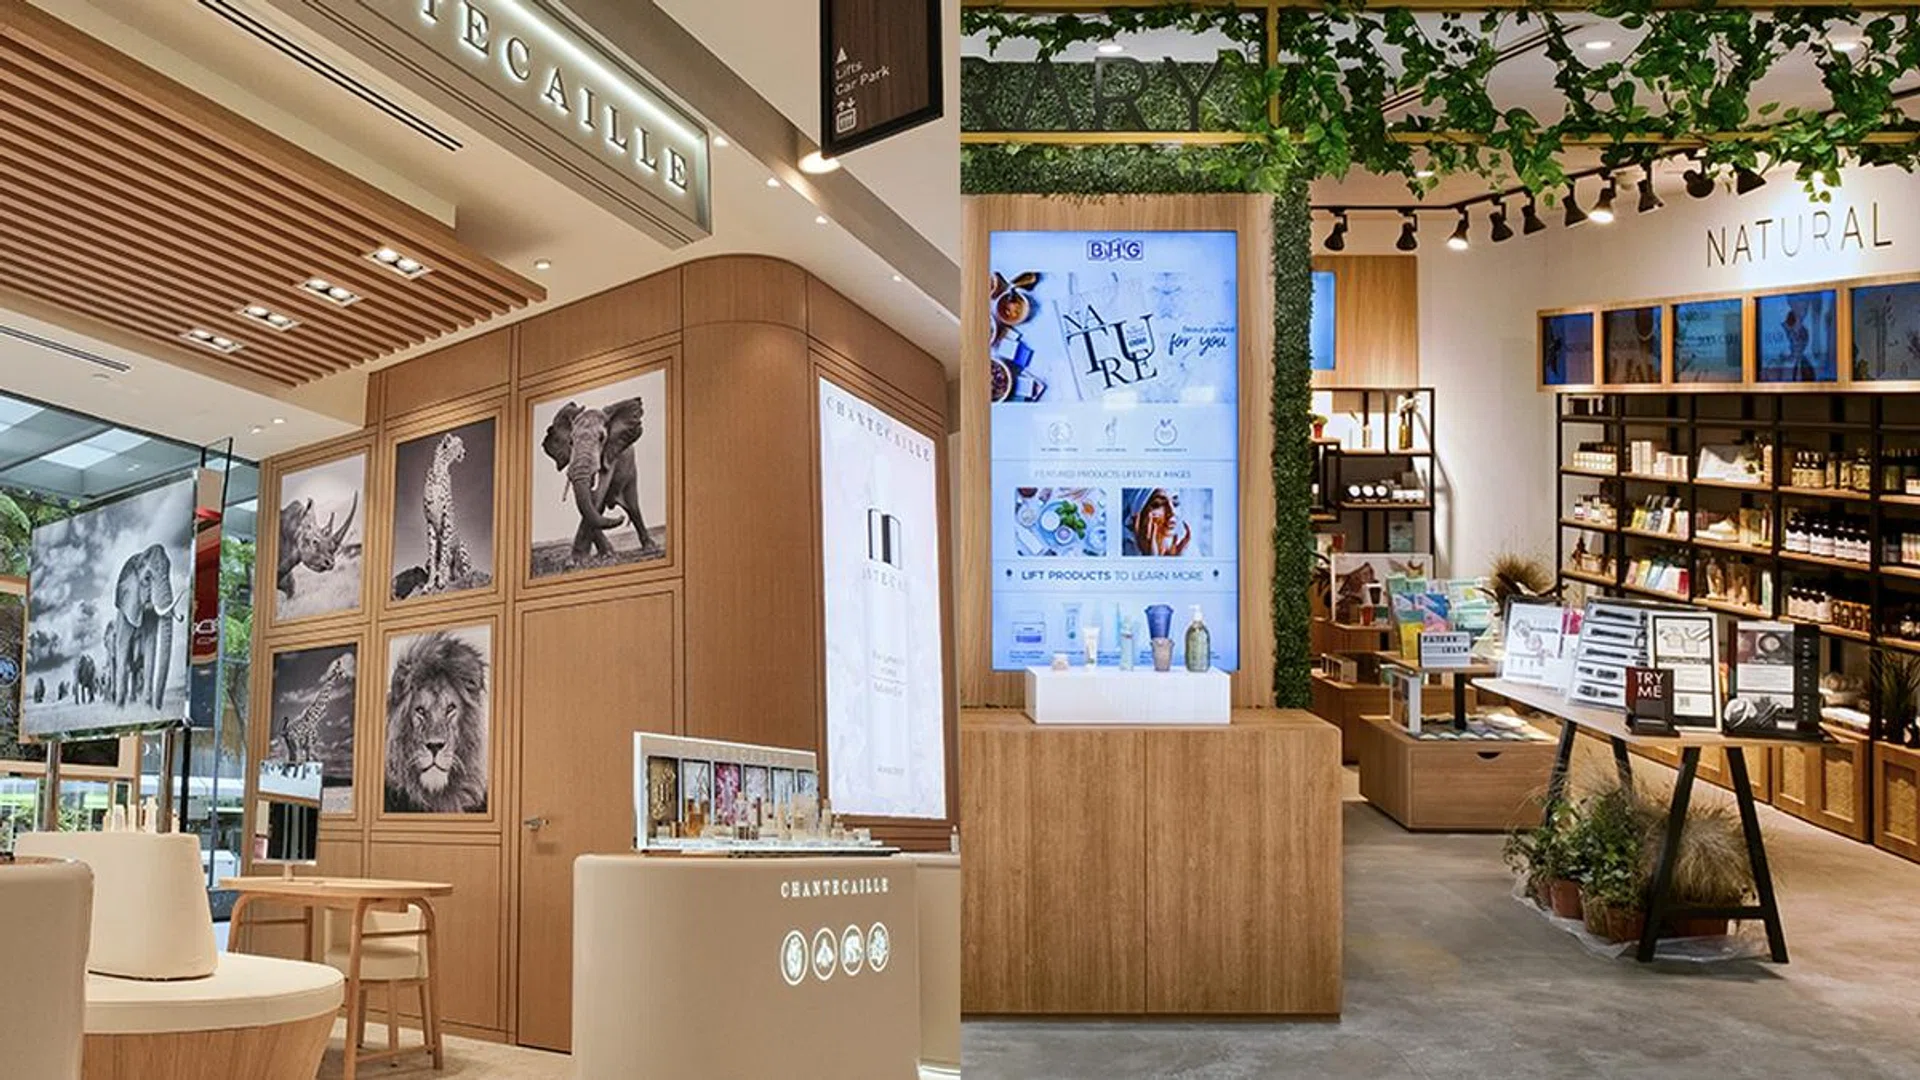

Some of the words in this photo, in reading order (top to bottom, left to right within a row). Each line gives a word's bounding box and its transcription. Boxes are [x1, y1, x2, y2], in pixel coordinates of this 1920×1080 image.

[835, 80, 857, 95] Car
[859, 65, 890, 86] Park
[1706, 202, 1893, 268] NATURAL
[1090, 241, 1141, 259] BHG
[1168, 333, 1192, 356] for
[1199, 335, 1227, 357] you
[1021, 570, 1045, 581] LIFT
[1048, 570, 1111, 581] PRODUCTS
[1115, 570, 1129, 581] TO
[1132, 570, 1169, 581] LEARN
[1172, 570, 1204, 581] MORE
[1636, 671, 1664, 685] TRY
[1637, 685, 1662, 698] ME
[780, 877, 888, 898] CHANTECAILLE
